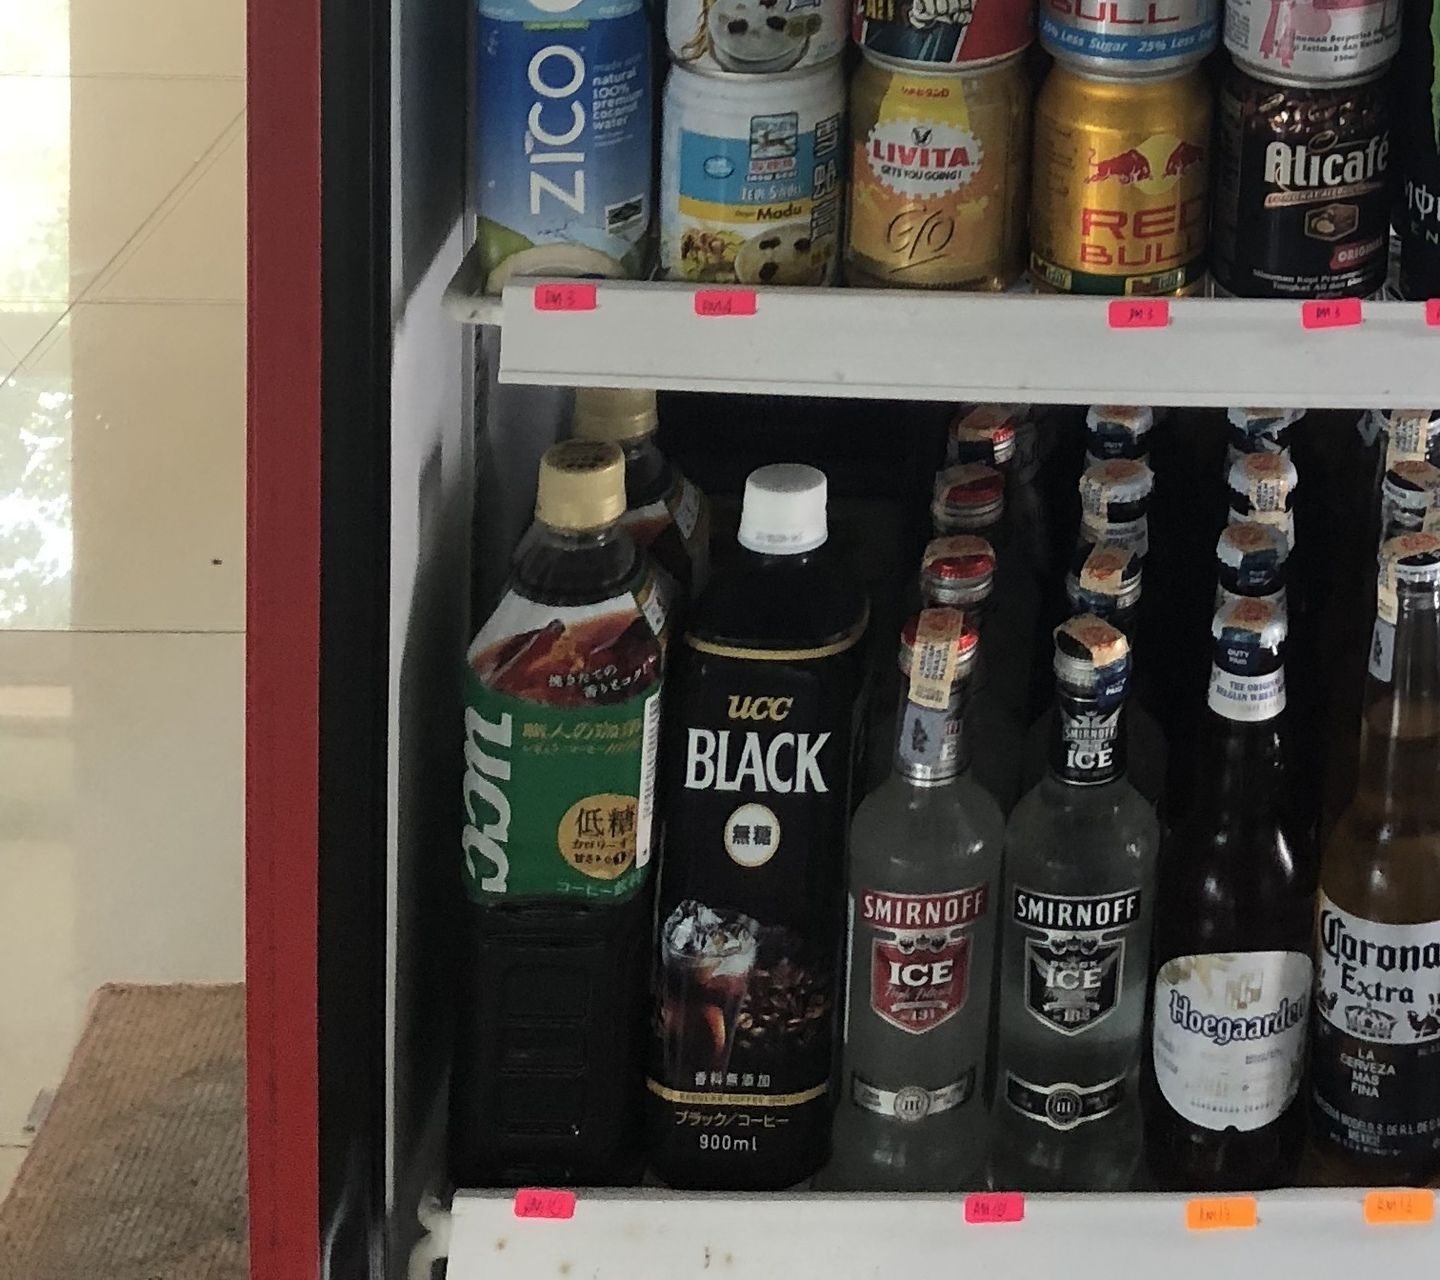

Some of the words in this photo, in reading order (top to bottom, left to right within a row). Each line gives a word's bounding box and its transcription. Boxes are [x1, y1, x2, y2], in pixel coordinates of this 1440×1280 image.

[527, 45, 585, 215] ZICO
[872, 140, 970, 169] LIVITA
[1264, 133, 1390, 187] Alicafé
[756, 204, 803, 222] Madu
[728, 694, 794, 722] ucc
[684, 727, 832, 793] BLACK
[1067, 748, 1113, 770] ICE
[463, 706, 512, 894] ucc
[576, 807, 637, 837] 低糖
[731, 823, 773, 846] 無糖
[863, 890, 984, 925] SMIRNOFF
[1017, 893, 1137, 928] SMIRNOFF
[888, 958, 954, 986] ICE
[1046, 967, 1103, 990] ICE
[1341, 964, 1414, 1004] Extra
[1340, 1053, 1396, 1076] CERVEZA
[694, 1071, 772, 1088] 香料無添加
[699, 1134, 758, 1153] 900ml
